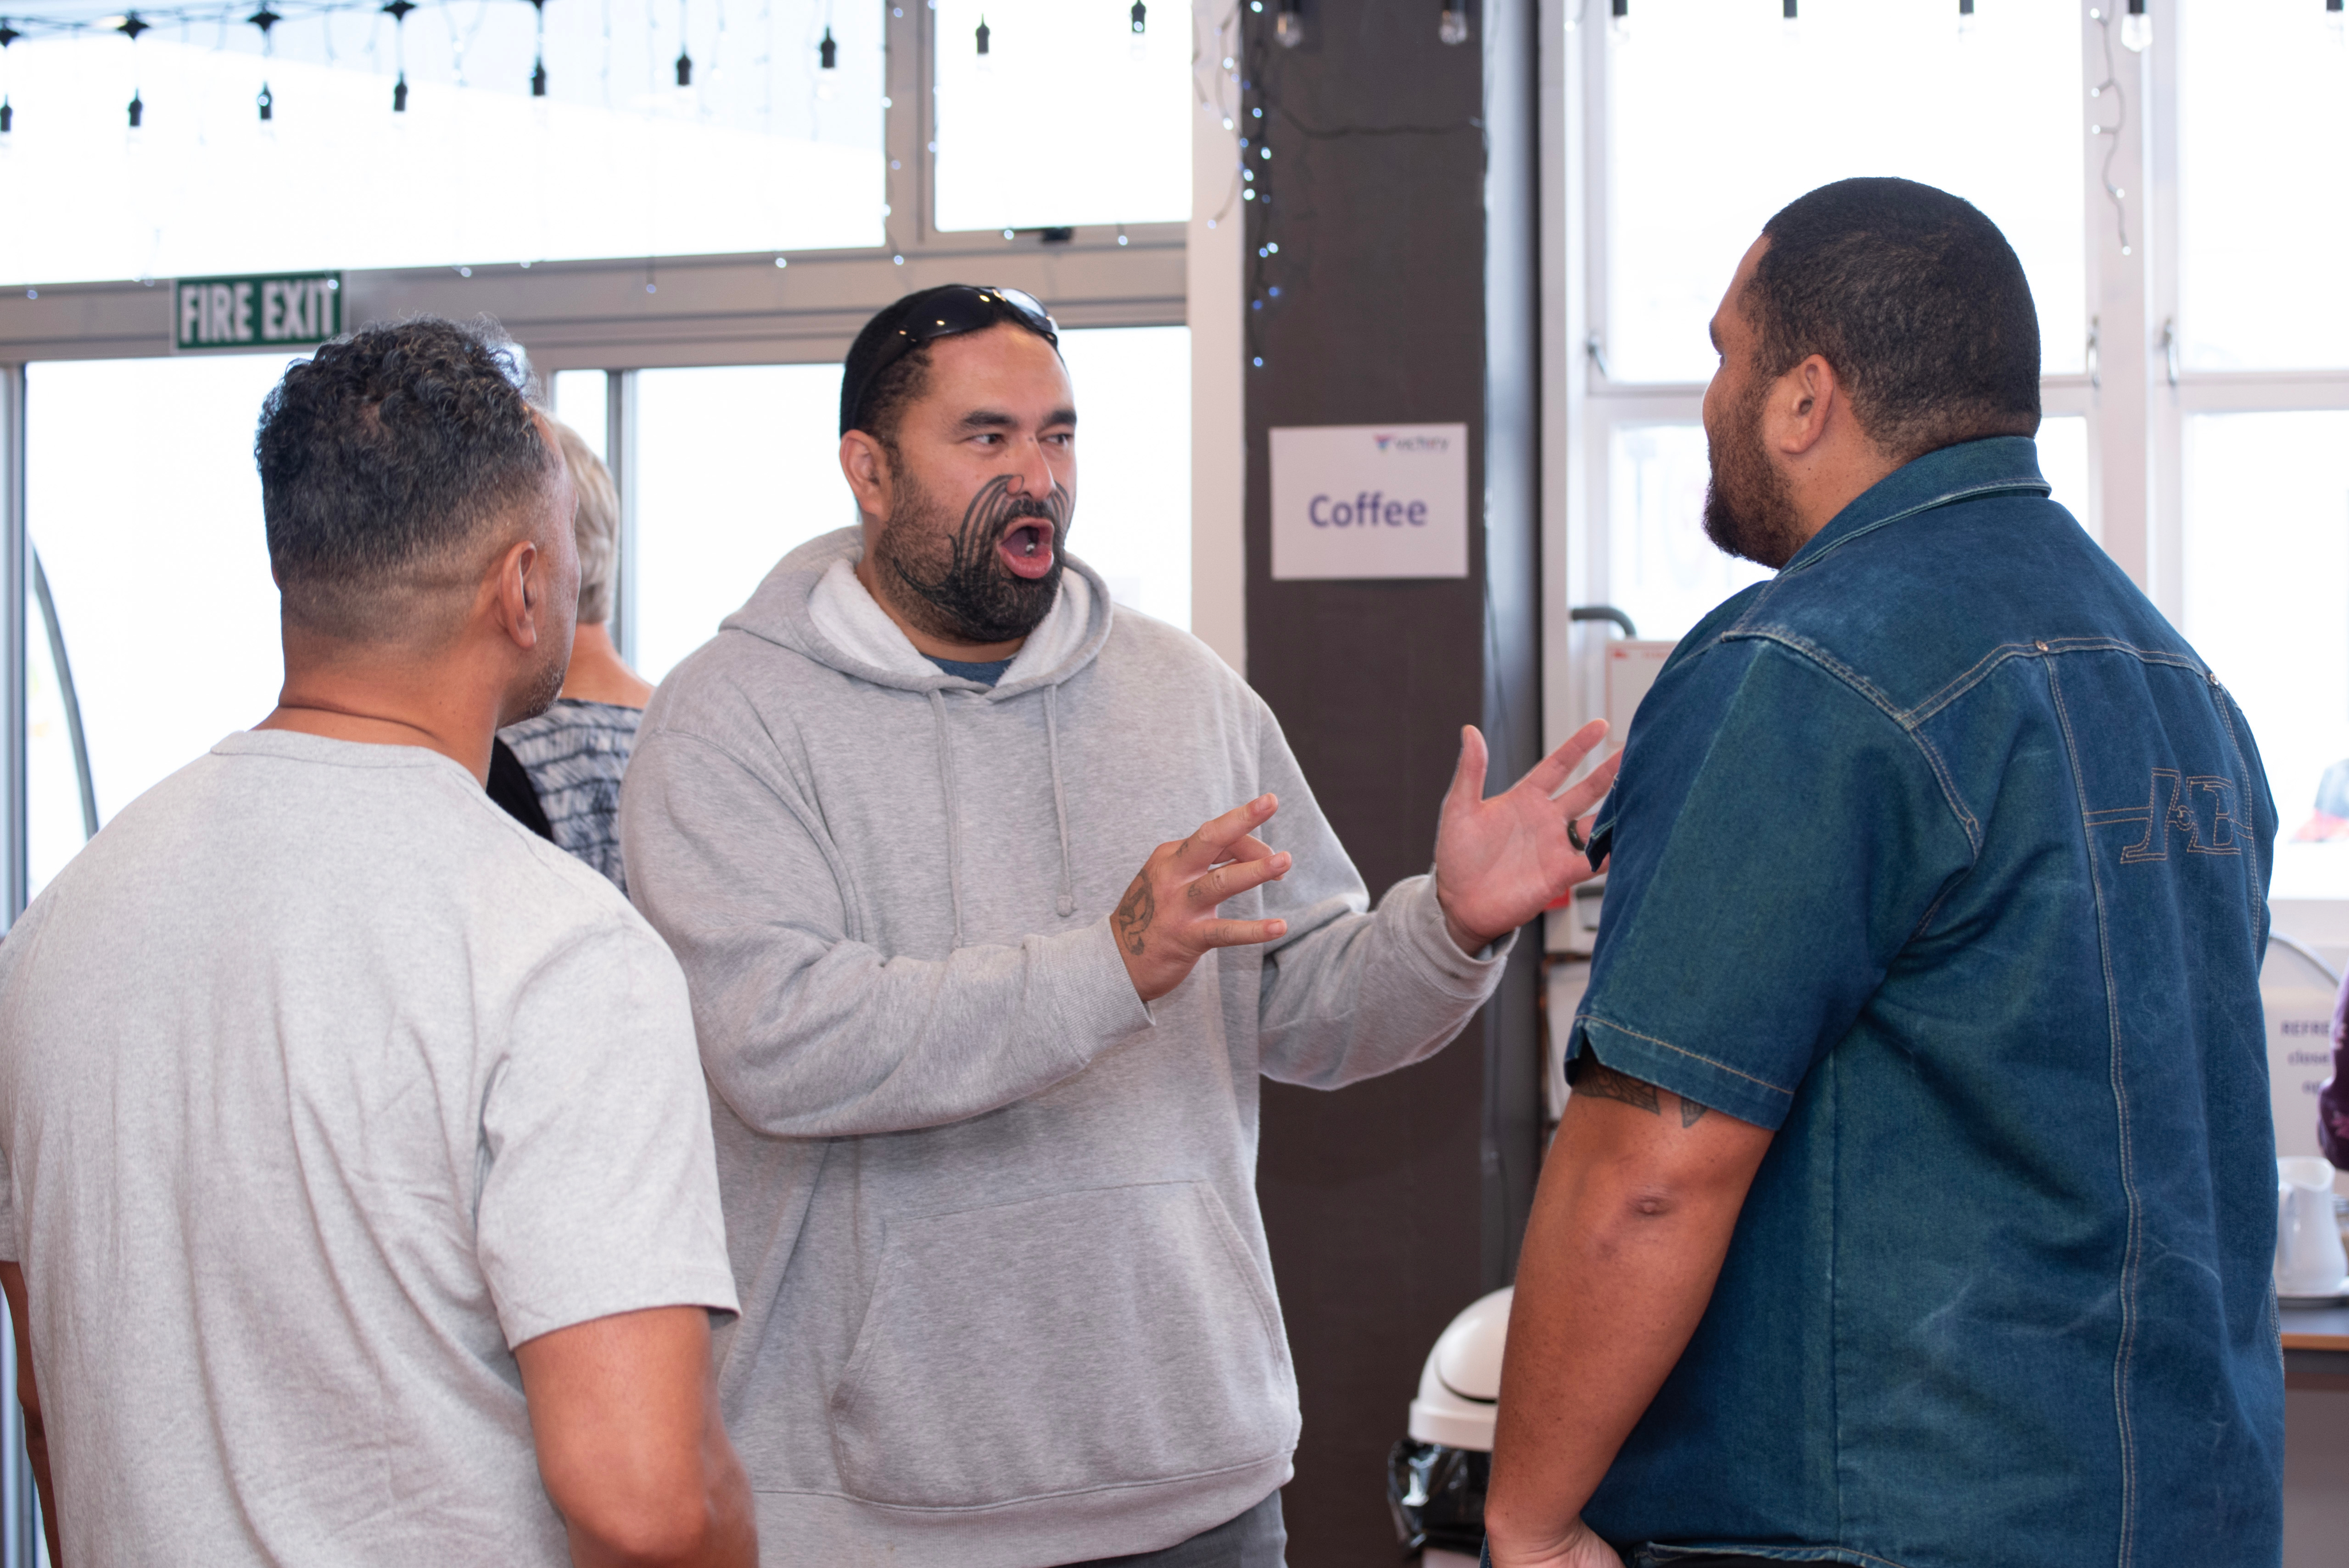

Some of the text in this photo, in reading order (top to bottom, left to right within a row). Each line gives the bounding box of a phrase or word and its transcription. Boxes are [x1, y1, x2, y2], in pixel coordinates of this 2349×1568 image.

[180, 279, 337, 343] FIRE EXIT
[1309, 491, 1427, 527] Coffee
